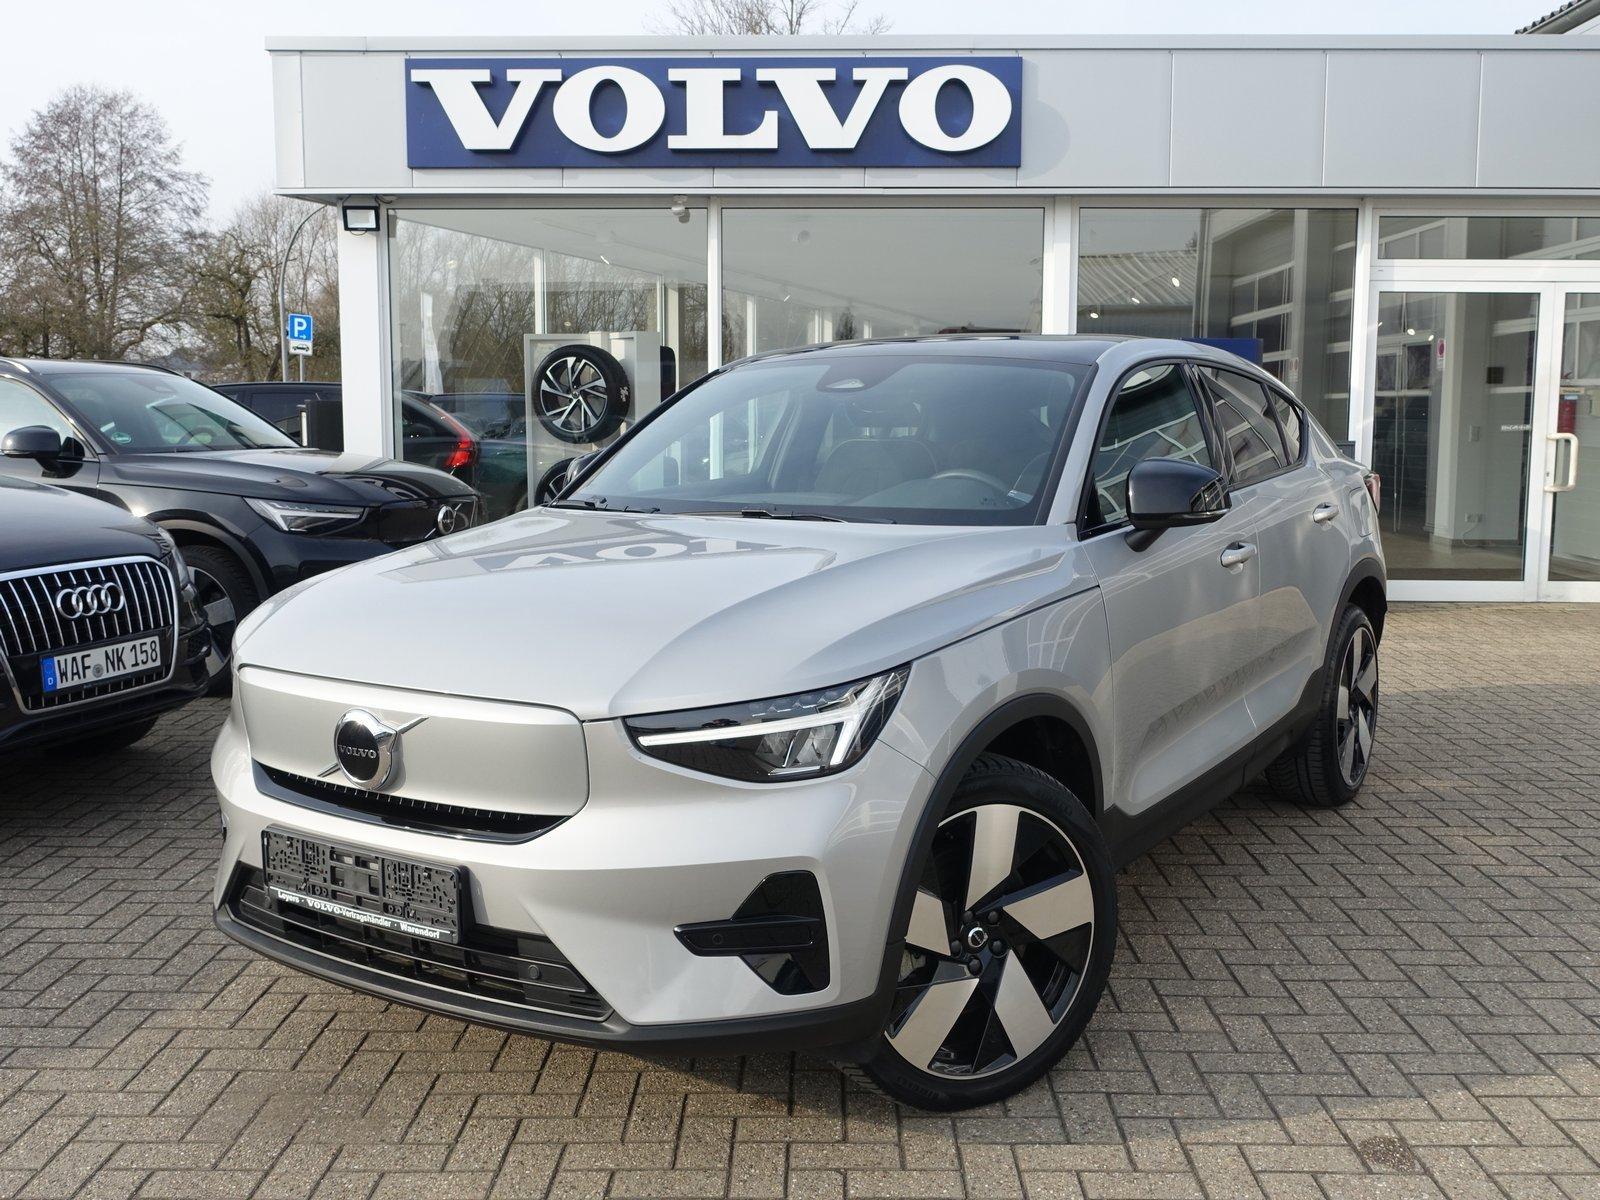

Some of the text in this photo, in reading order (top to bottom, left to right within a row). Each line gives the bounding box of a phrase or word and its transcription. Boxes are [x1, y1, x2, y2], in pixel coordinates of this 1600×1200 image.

[410, 64, 1012, 152] VOLVO
[294, 317, 307, 338] P
[48, 640, 158, 686] D WAF NK 158
[338, 744, 377, 759] VOLVO
[399, 922, 440, 939] Warendorf
